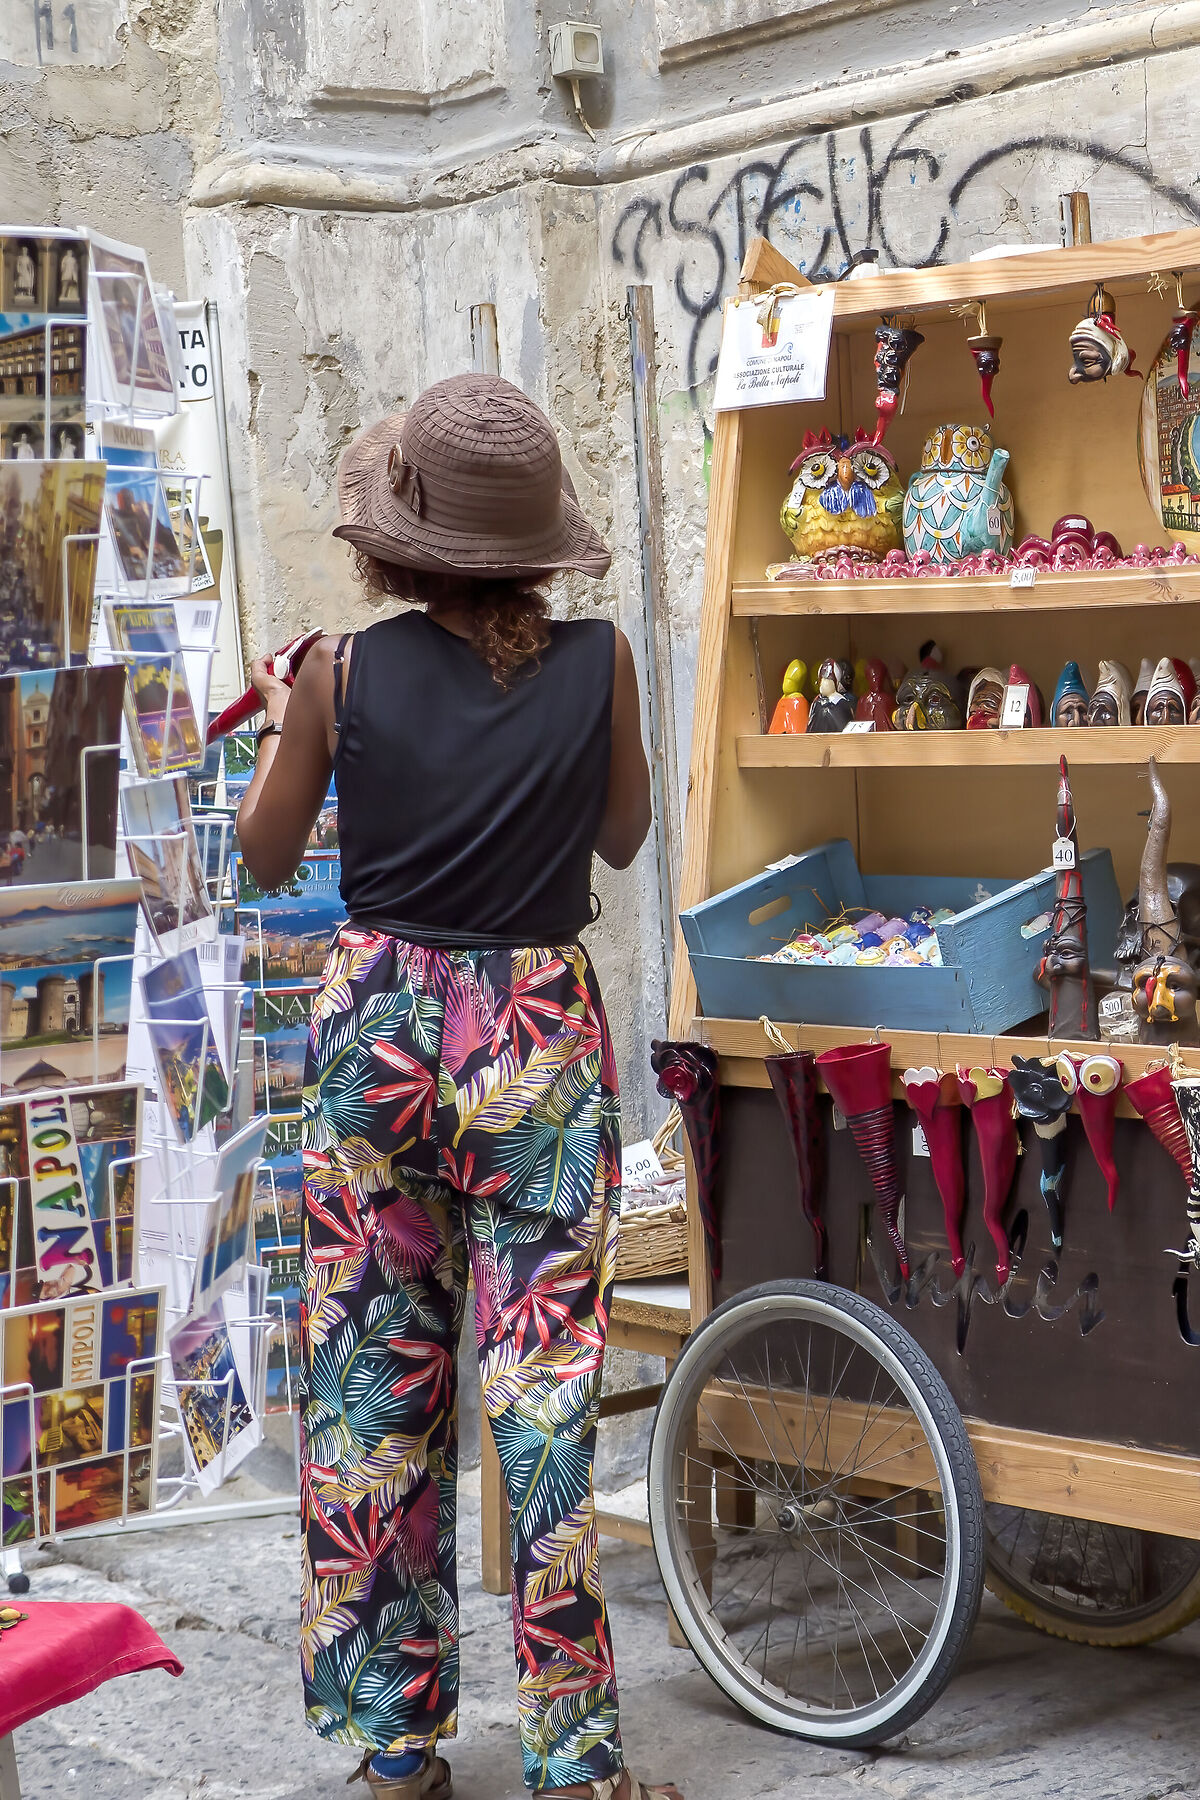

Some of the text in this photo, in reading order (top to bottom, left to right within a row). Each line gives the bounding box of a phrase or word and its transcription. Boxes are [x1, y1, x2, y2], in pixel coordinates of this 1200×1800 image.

[772, 364, 805, 374] CULTURALE
[748, 376, 769, 389] Bella
[113, 428, 144, 446] NAPOLI
[1010, 701, 1021, 713] 12
[1055, 849, 1073, 862] 40
[625, 1159, 650, 1175] 5,00
[29, 1095, 94, 1272] NAPOLI
[71, 1303, 96, 1384] NAPOLI
